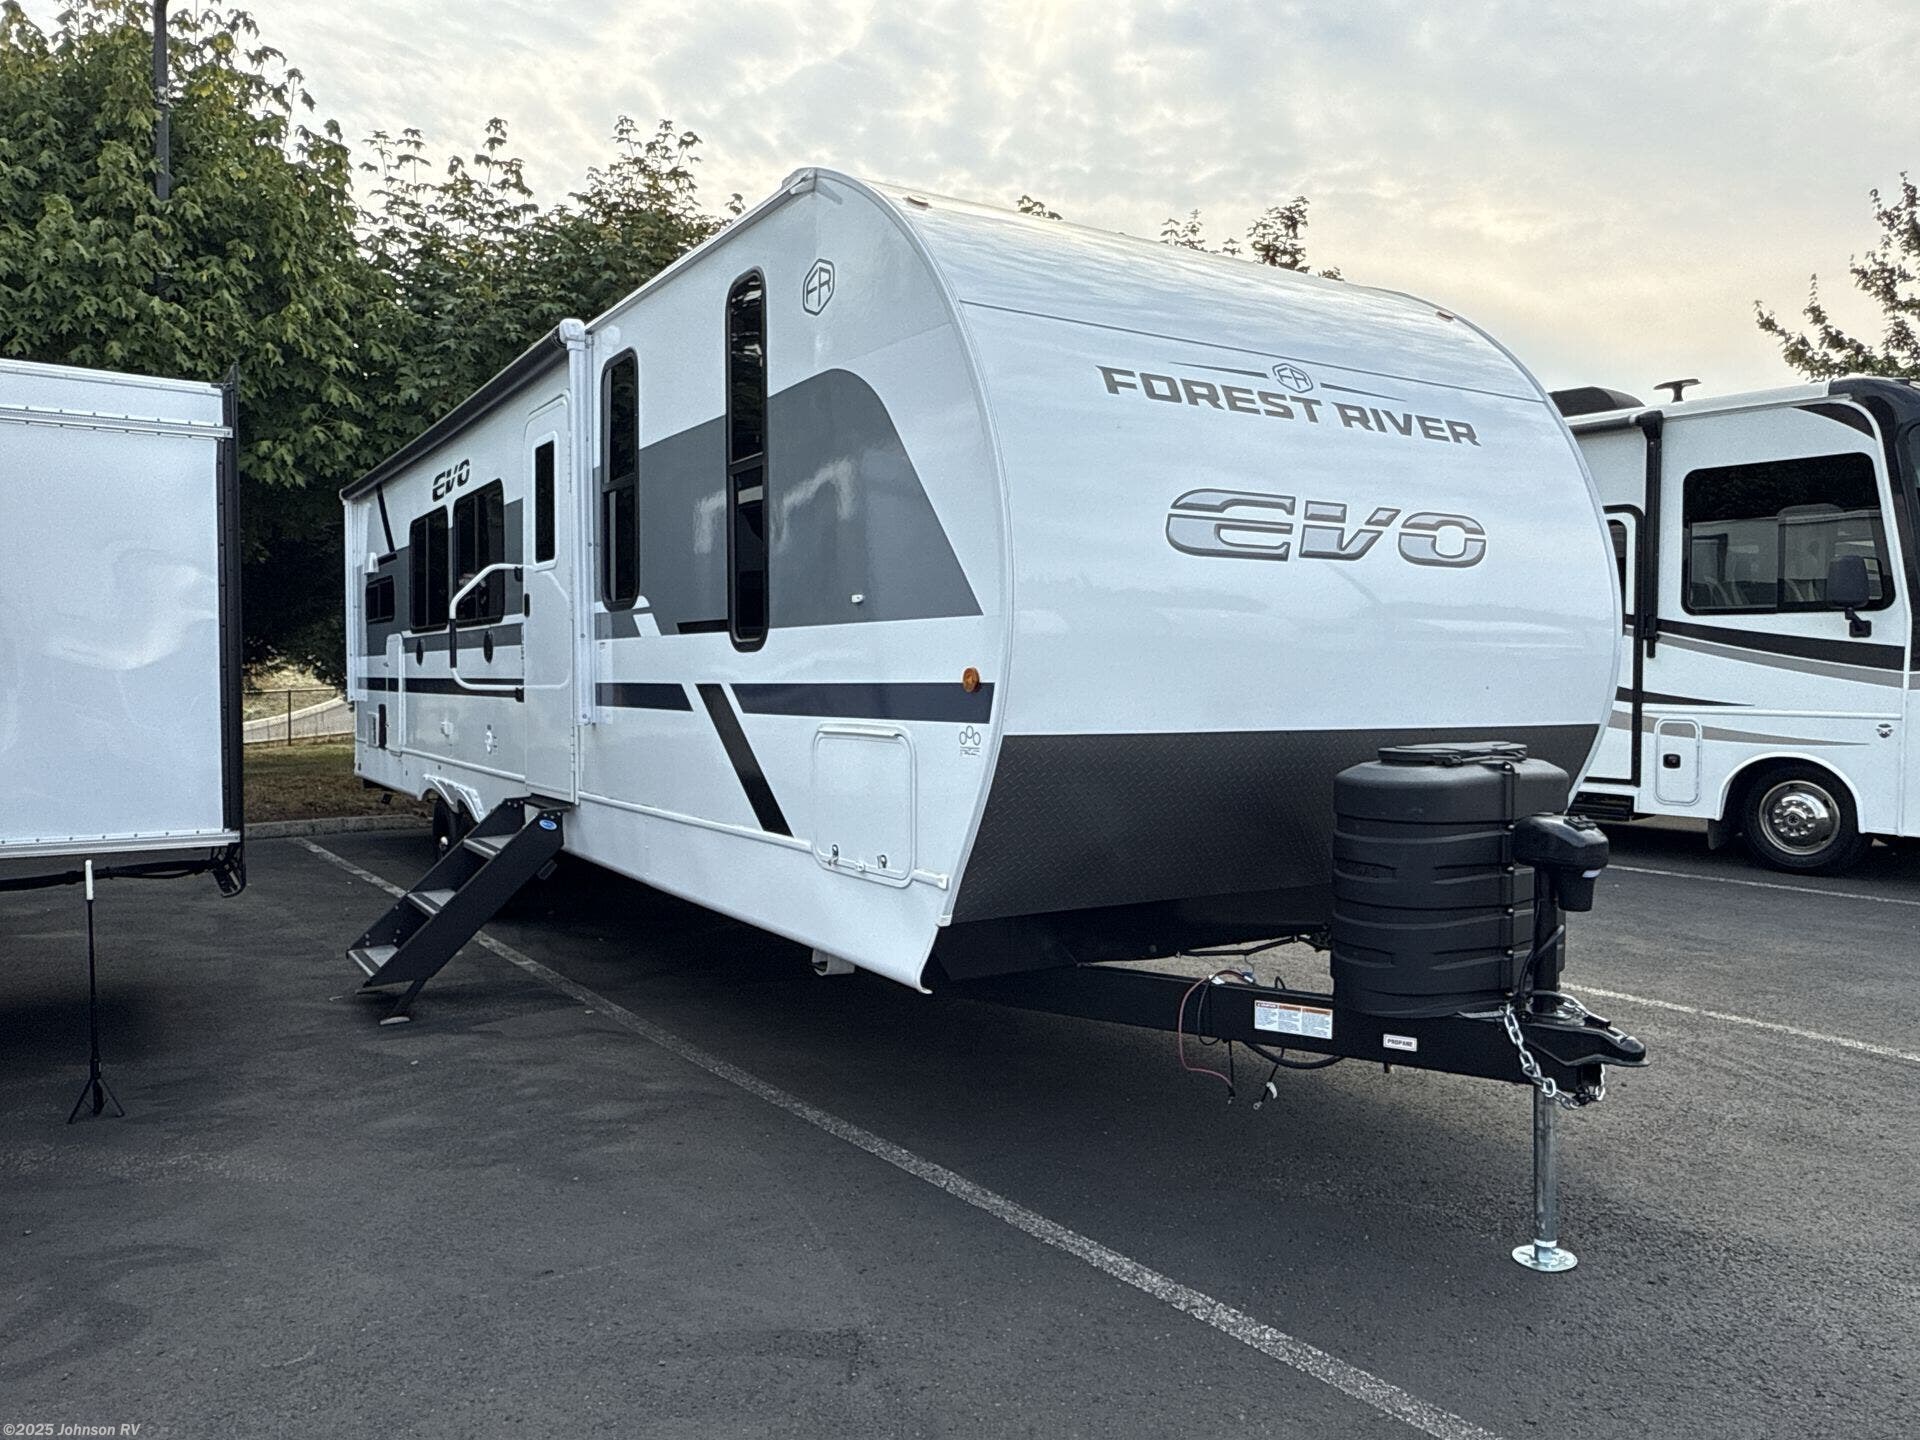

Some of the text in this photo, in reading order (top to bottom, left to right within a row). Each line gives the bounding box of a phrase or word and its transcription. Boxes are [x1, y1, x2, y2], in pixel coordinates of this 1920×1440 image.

[1095, 365, 1482, 447] FOREST RIVER
[432, 459, 470, 502] EVO
[1165, 488, 1487, 568] EVO
[1387, 1038, 1413, 1047] PROPANE
